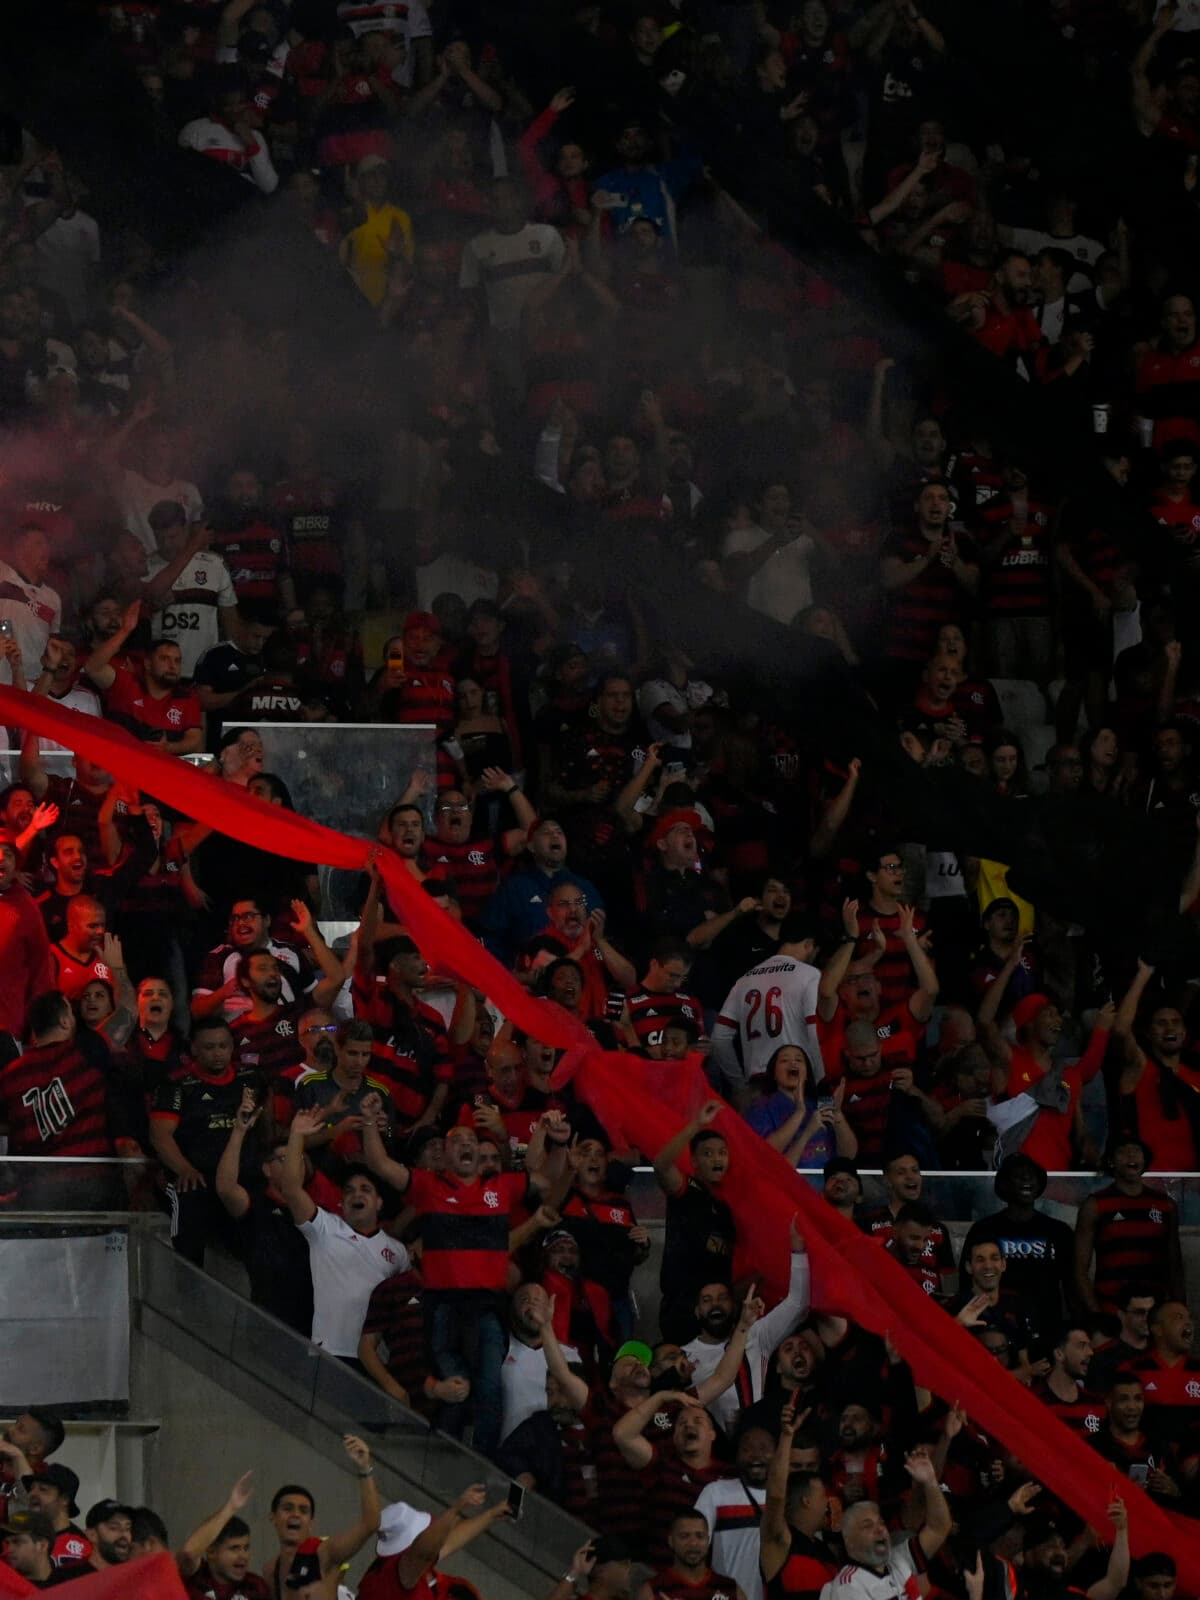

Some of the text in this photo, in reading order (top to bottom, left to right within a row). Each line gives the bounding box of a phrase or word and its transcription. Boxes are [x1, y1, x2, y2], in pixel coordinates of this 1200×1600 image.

[251, 695, 302, 711] MRV
[744, 985, 783, 1042] 26
[22, 1076, 76, 1142] 10
